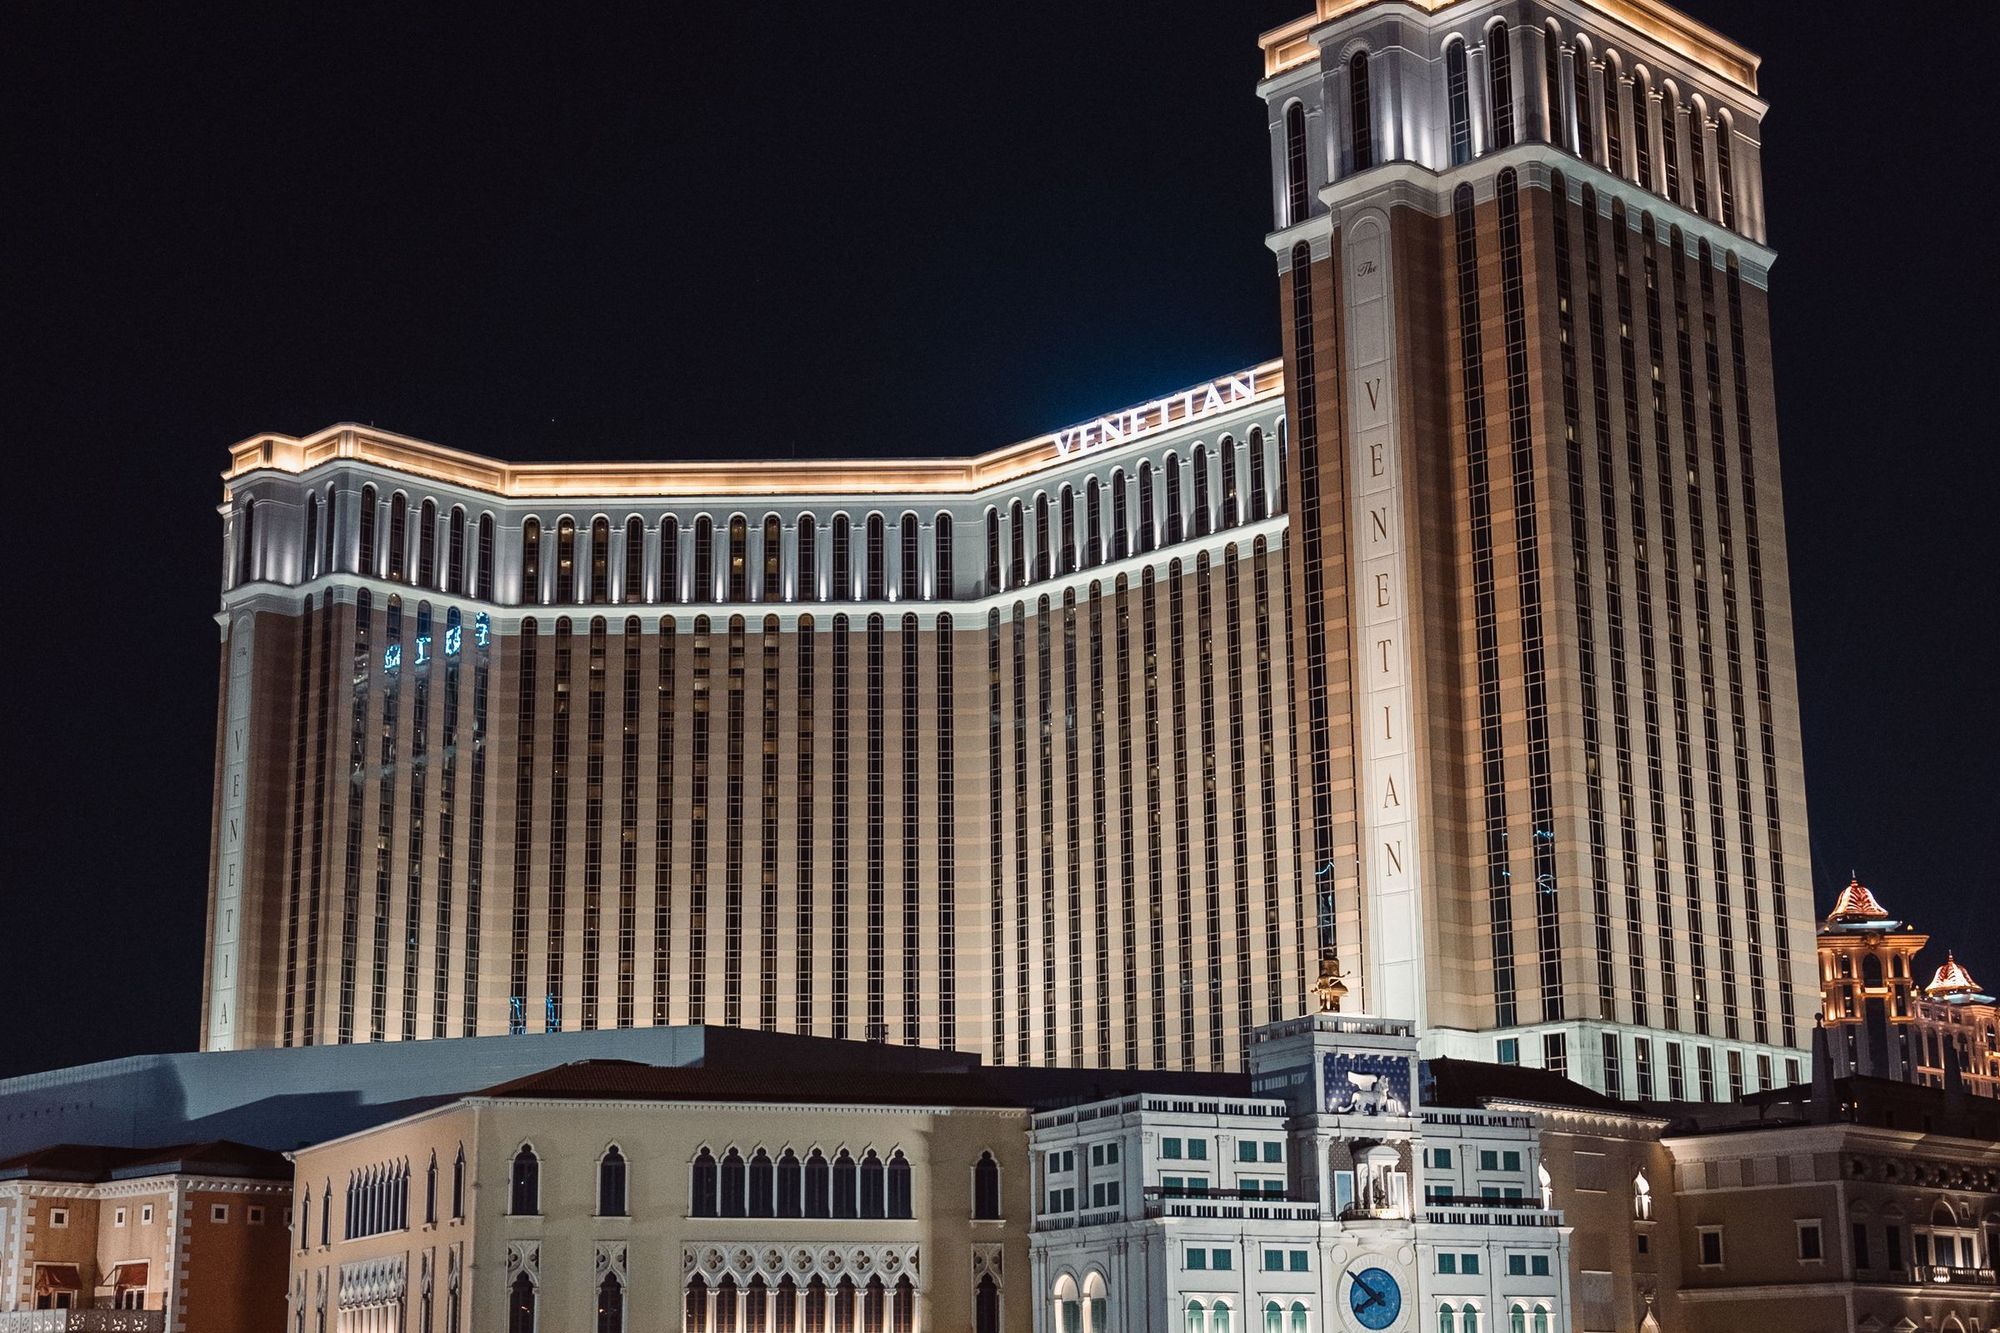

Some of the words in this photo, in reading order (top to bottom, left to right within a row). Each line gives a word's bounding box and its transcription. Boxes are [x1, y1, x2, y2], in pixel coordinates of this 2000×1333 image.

[1357, 261, 1377, 278] The
[1052, 369, 1258, 457] VENETIAN
[1365, 378, 1402, 877] VENETIAN
[218, 729, 243, 1051] VENETIA
